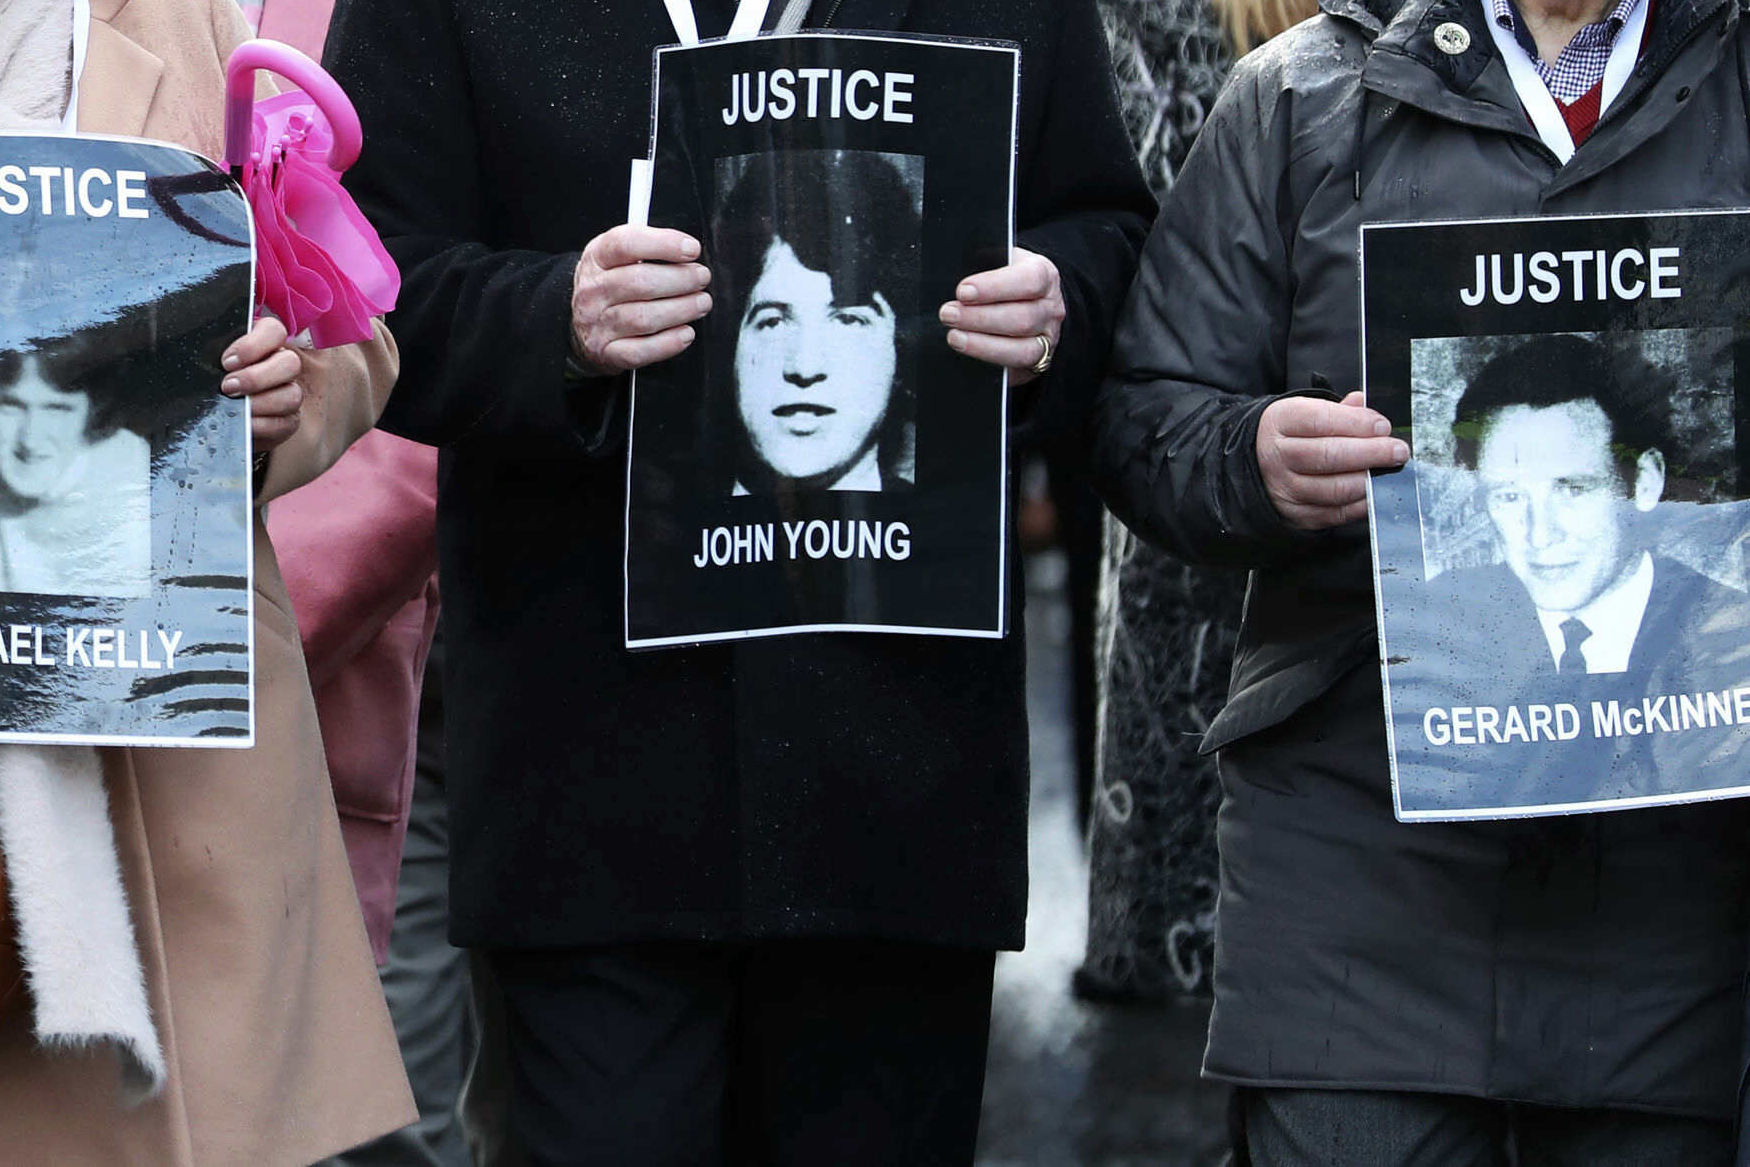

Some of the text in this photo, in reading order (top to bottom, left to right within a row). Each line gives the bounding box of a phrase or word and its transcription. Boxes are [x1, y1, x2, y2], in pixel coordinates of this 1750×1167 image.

[722, 68, 914, 125] JUSTICE
[1460, 247, 1681, 306] JUSTICE
[694, 520, 910, 569] JOHN YOUNG
[66, 627, 183, 670] KELLY
[1423, 703, 1581, 746] GERARD
